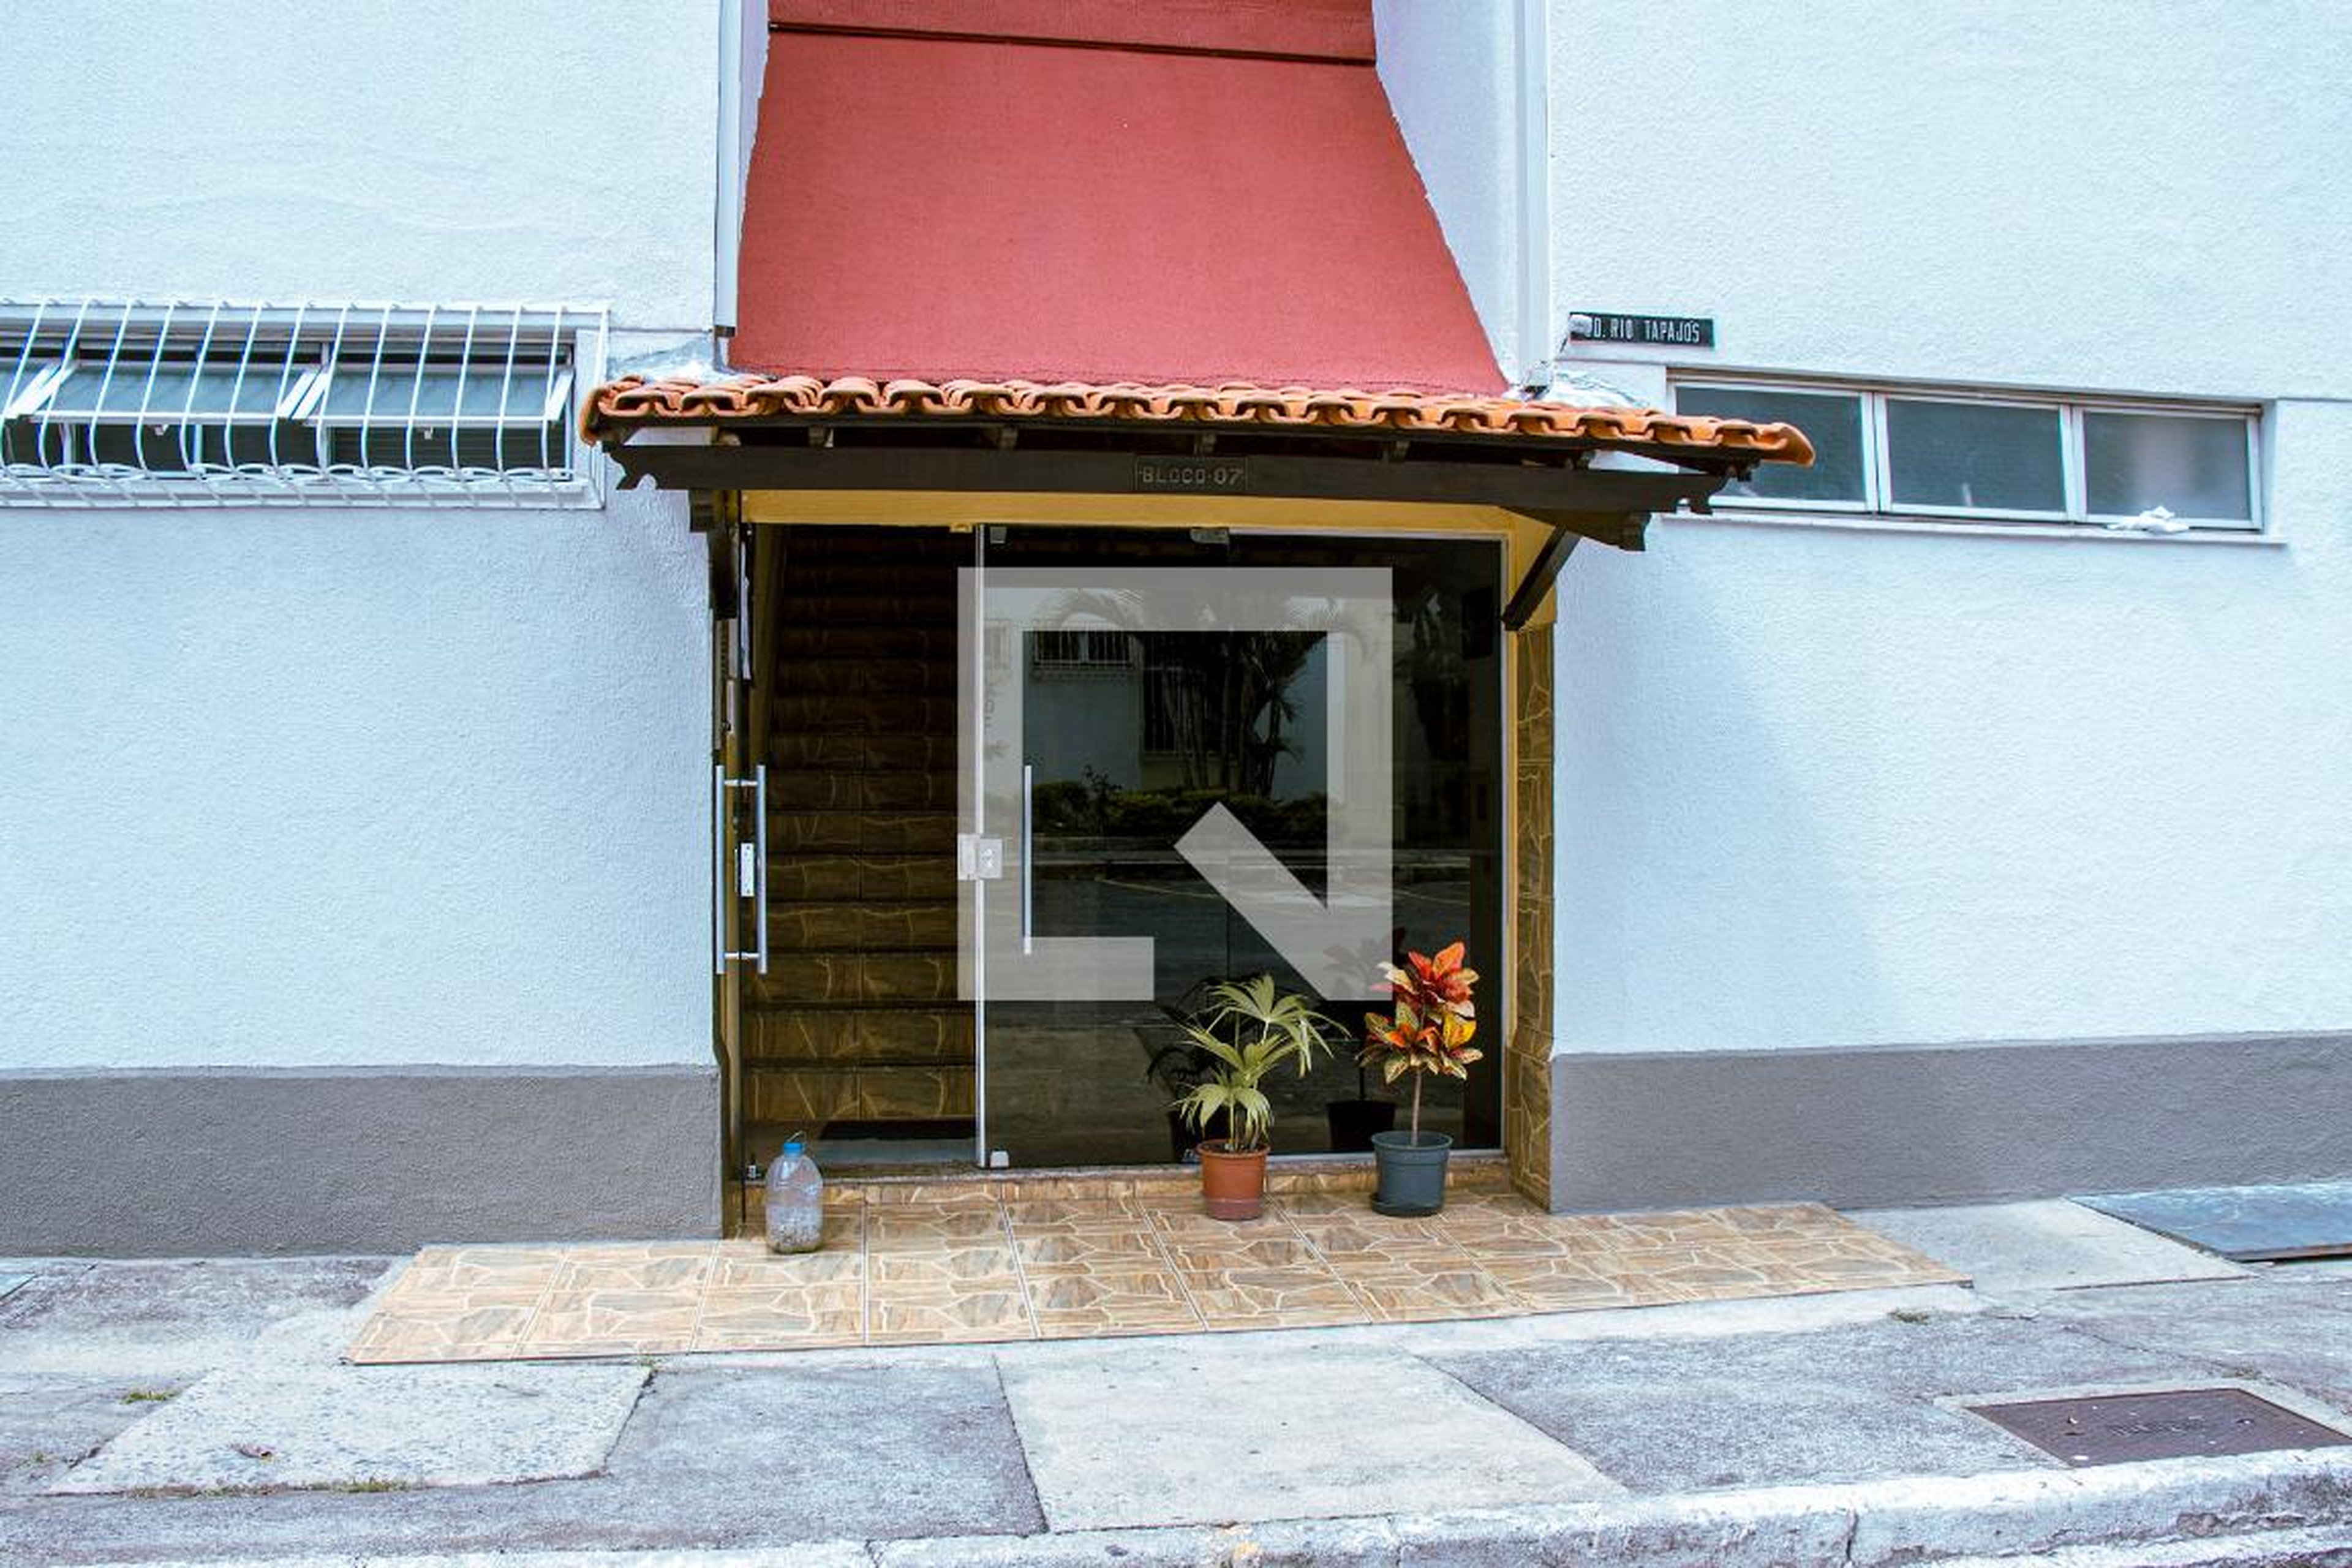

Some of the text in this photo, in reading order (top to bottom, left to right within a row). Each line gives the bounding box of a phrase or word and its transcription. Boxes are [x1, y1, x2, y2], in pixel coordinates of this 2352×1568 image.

[1610, 318, 1634, 339] RIO
[1645, 320, 1700, 343] TAPAJÓS
[1143, 466, 1206, 484] BLOCO
